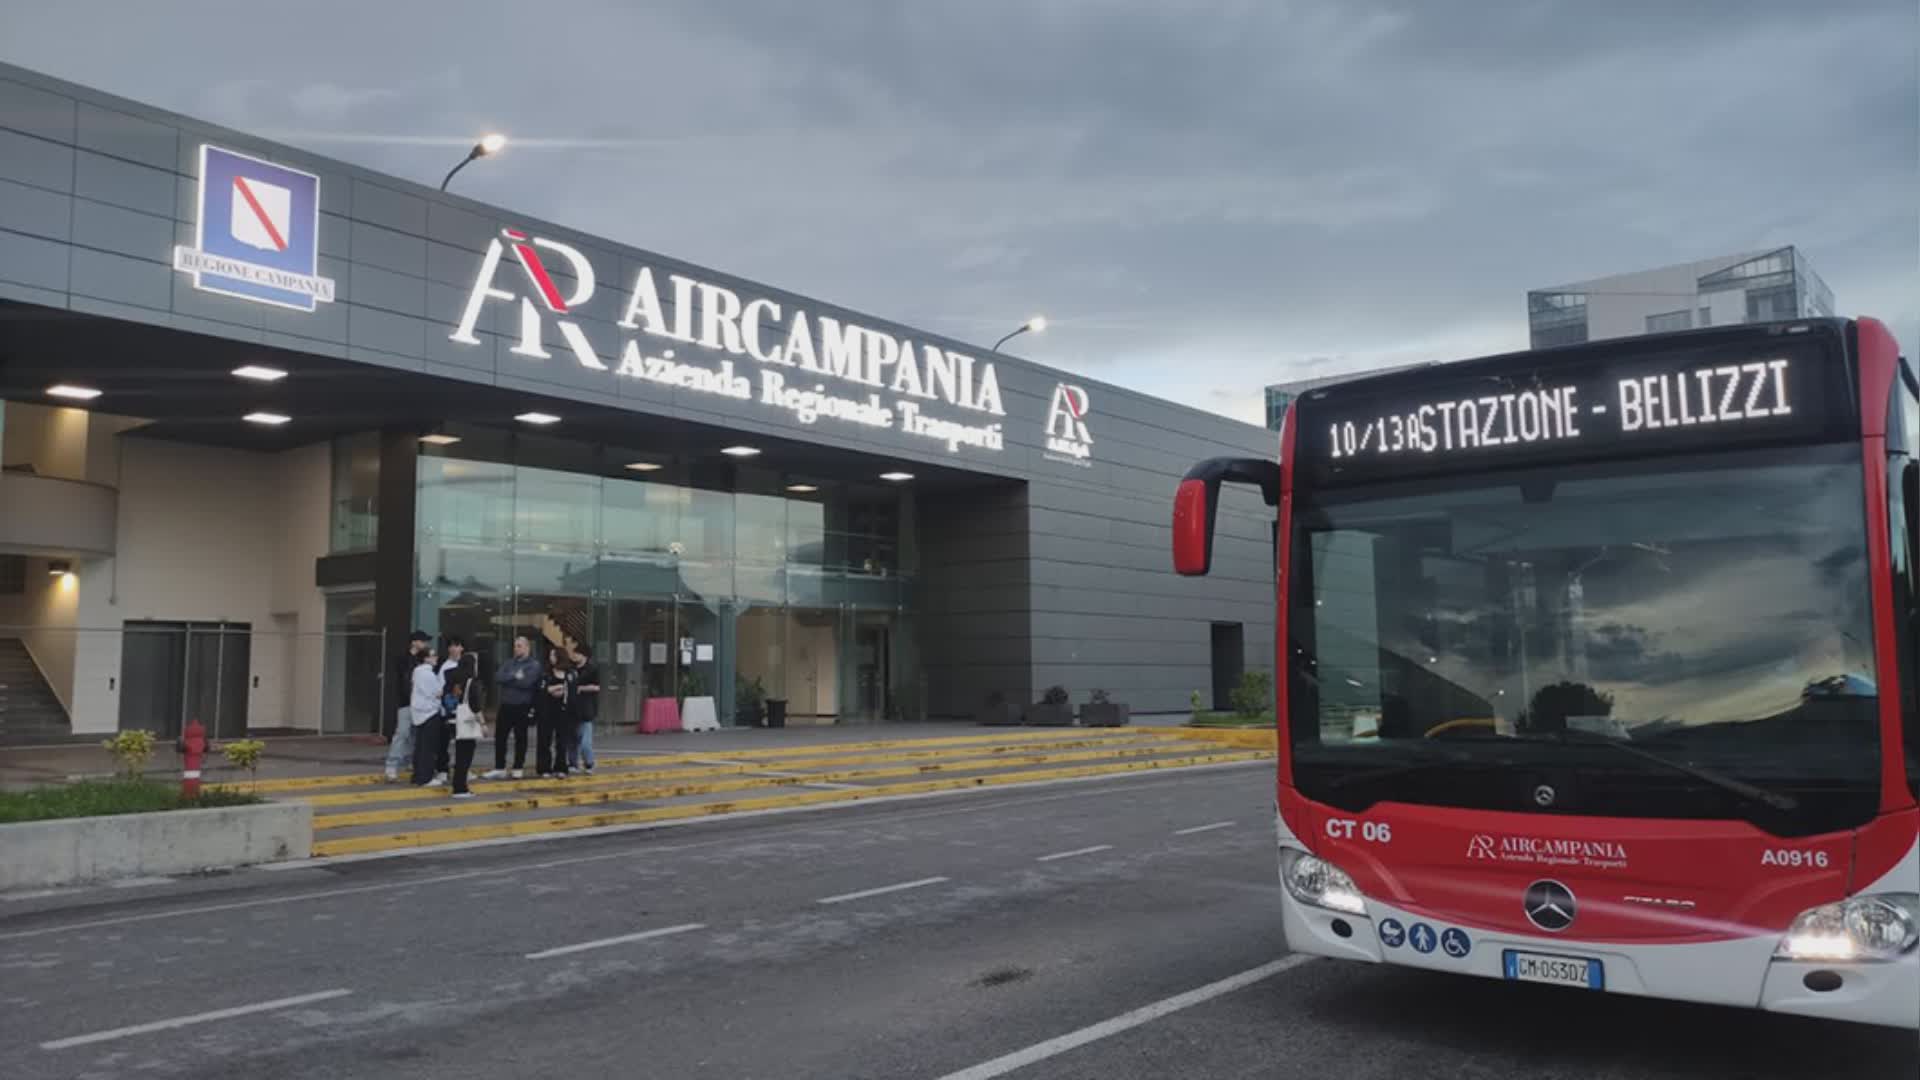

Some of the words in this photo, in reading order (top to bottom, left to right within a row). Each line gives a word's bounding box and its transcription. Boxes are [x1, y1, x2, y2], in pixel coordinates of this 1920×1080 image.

[183, 253, 249, 277] REGIONE
[255, 269, 329, 297] CAMPANIA
[617, 266, 1007, 416] AIRCAMPANIA
[616, 339, 752, 399] Azienda
[760, 370, 894, 428] Regionale
[1419, 386, 1580, 452] STAZIONE
[1618, 359, 1792, 431] BELLIZZI
[1326, 818, 1357, 839] CT
[1362, 821, 1392, 843] 06
[1500, 836, 1627, 859] AIRCAMPANIA
[1761, 849, 1829, 867] A0916
